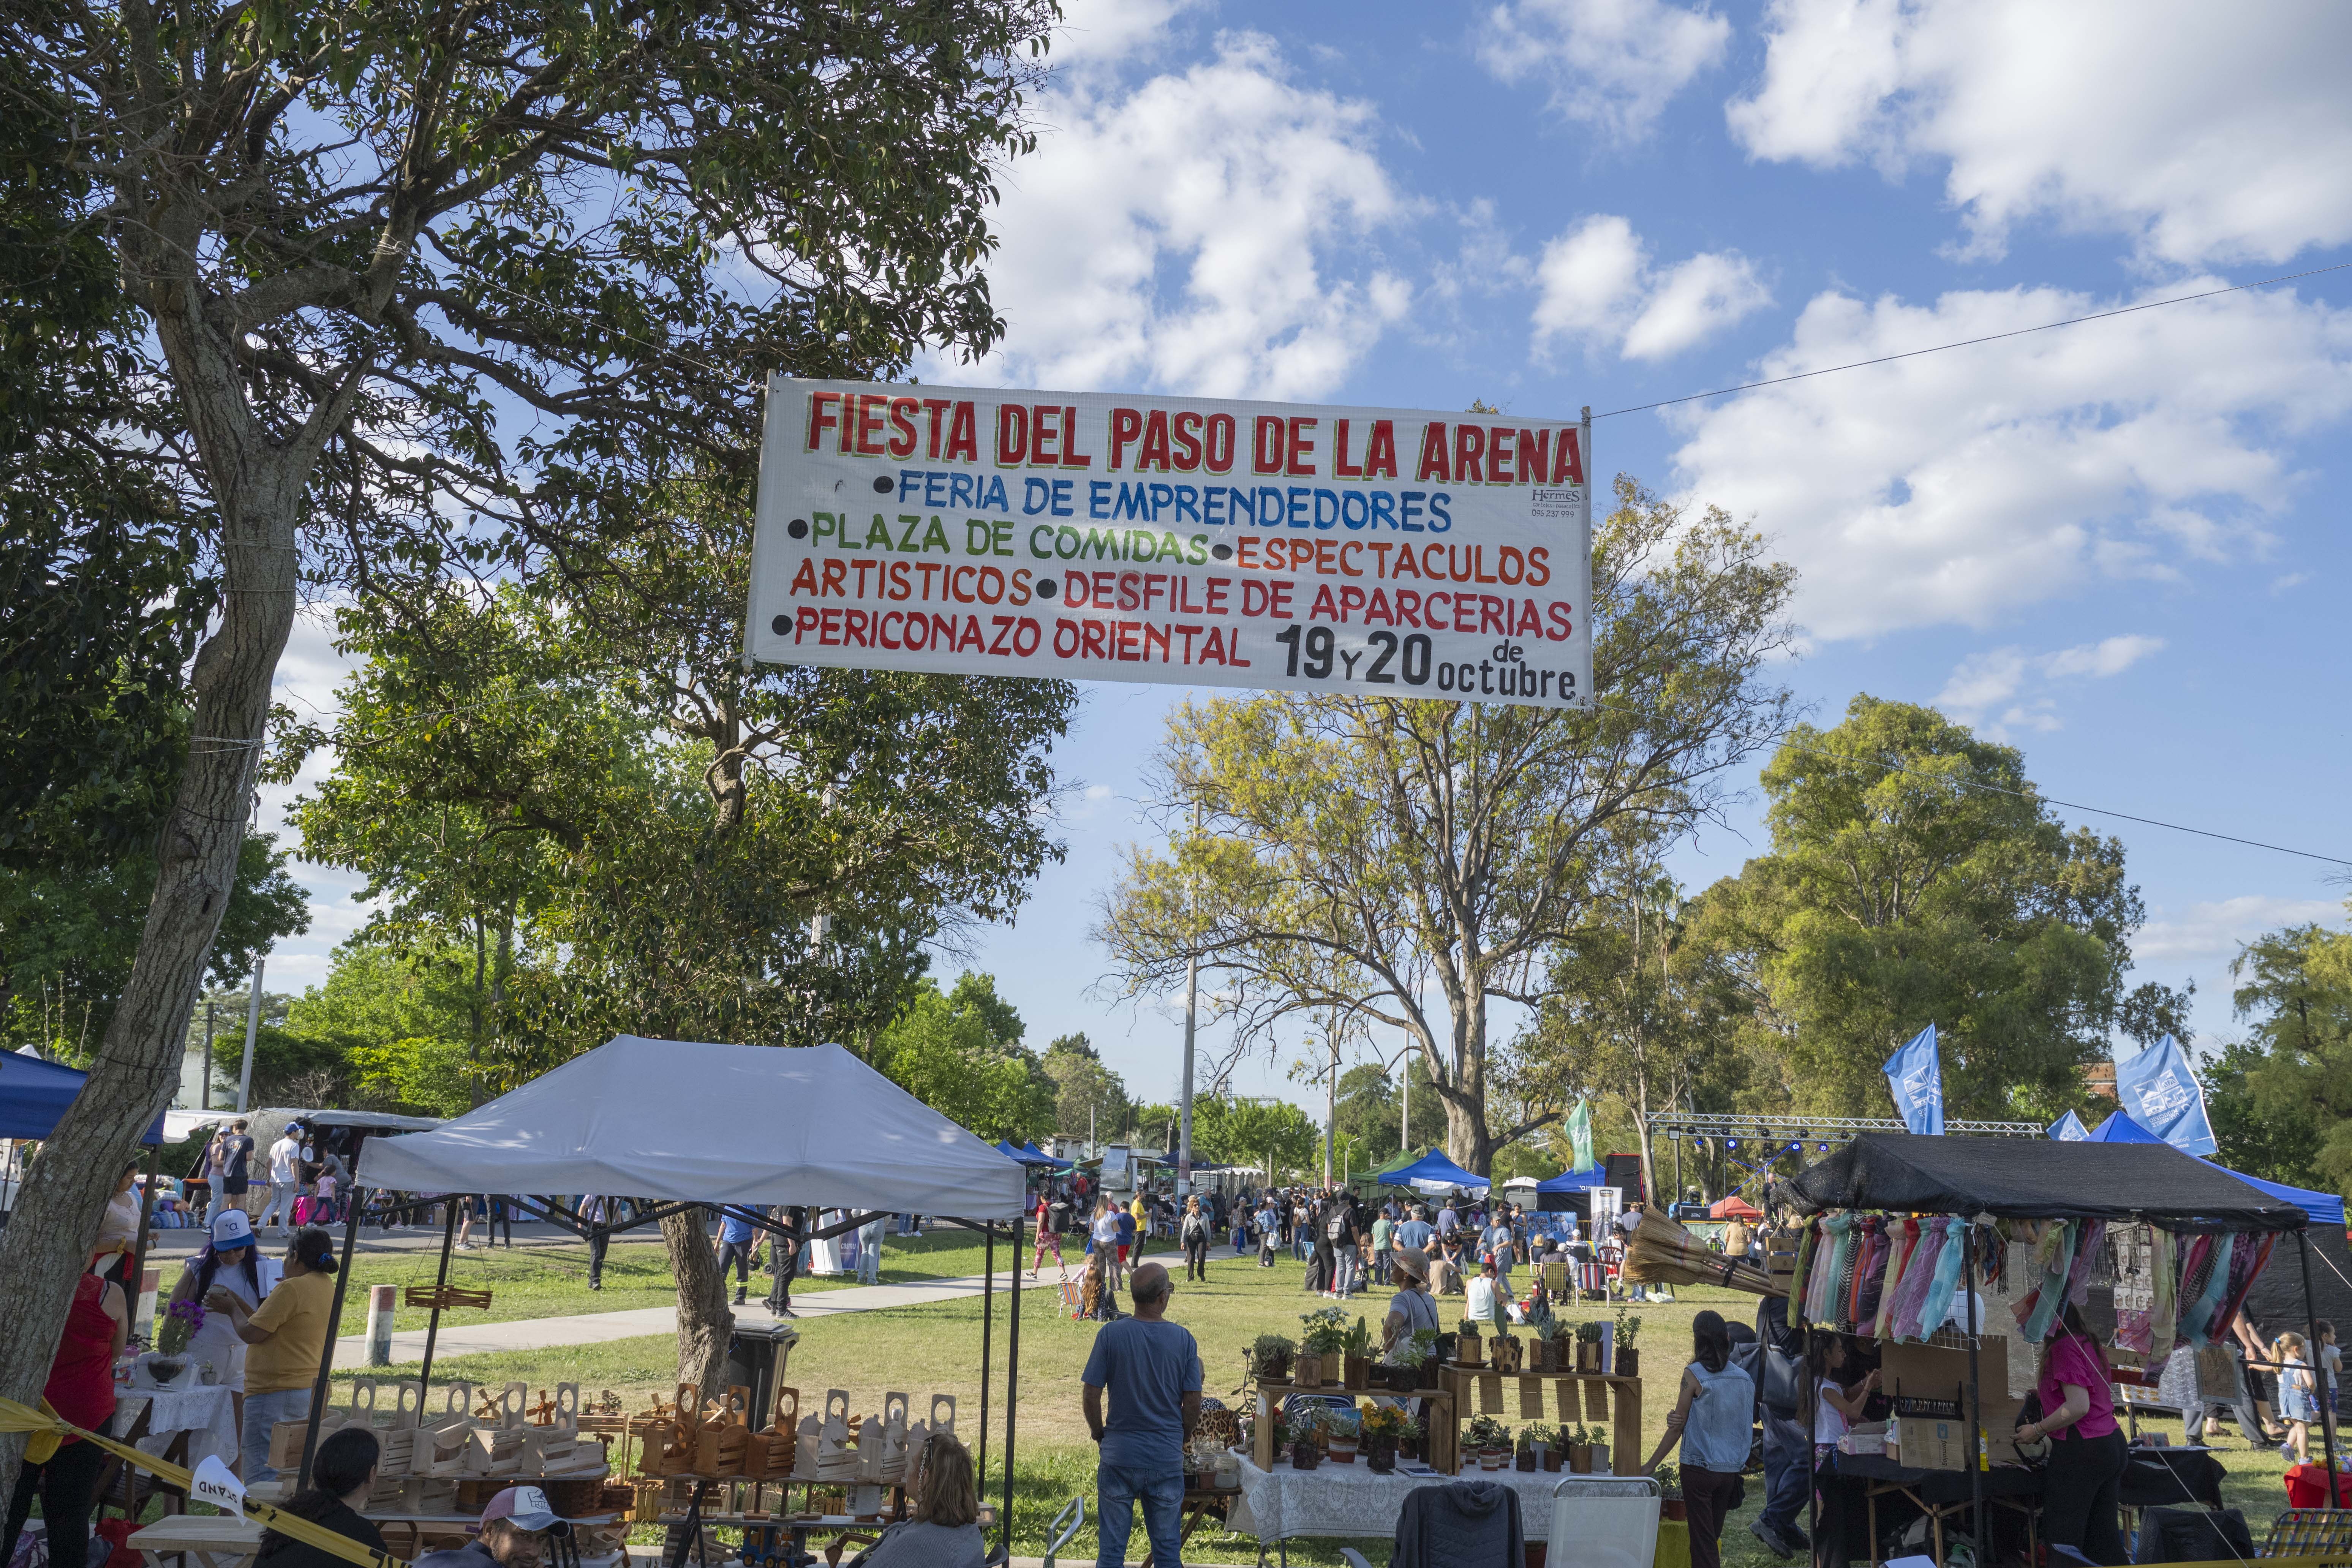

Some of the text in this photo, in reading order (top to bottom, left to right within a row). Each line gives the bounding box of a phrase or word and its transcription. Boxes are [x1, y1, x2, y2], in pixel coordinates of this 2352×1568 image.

[803, 391, 1584, 488] FIESTA DEL PASO DE LA ARENA
[898, 469, 1452, 533] FERIA DE EMPRENDEDORES
[811, 511, 1550, 586] PLAZA DE COMIDAS ESPECTACULOS
[789, 557, 1573, 642] ARTISTICOS DESFILE DE APARCERIAS
[794, 605, 1251, 667] PERICONAZO ORIENTAL
[1276, 624, 1335, 679] 19
[1365, 630, 1432, 686] 20
[1492, 639, 1524, 663] de
[1438, 659, 1576, 700] octubre
[199, 1481, 237, 1504] STAND
